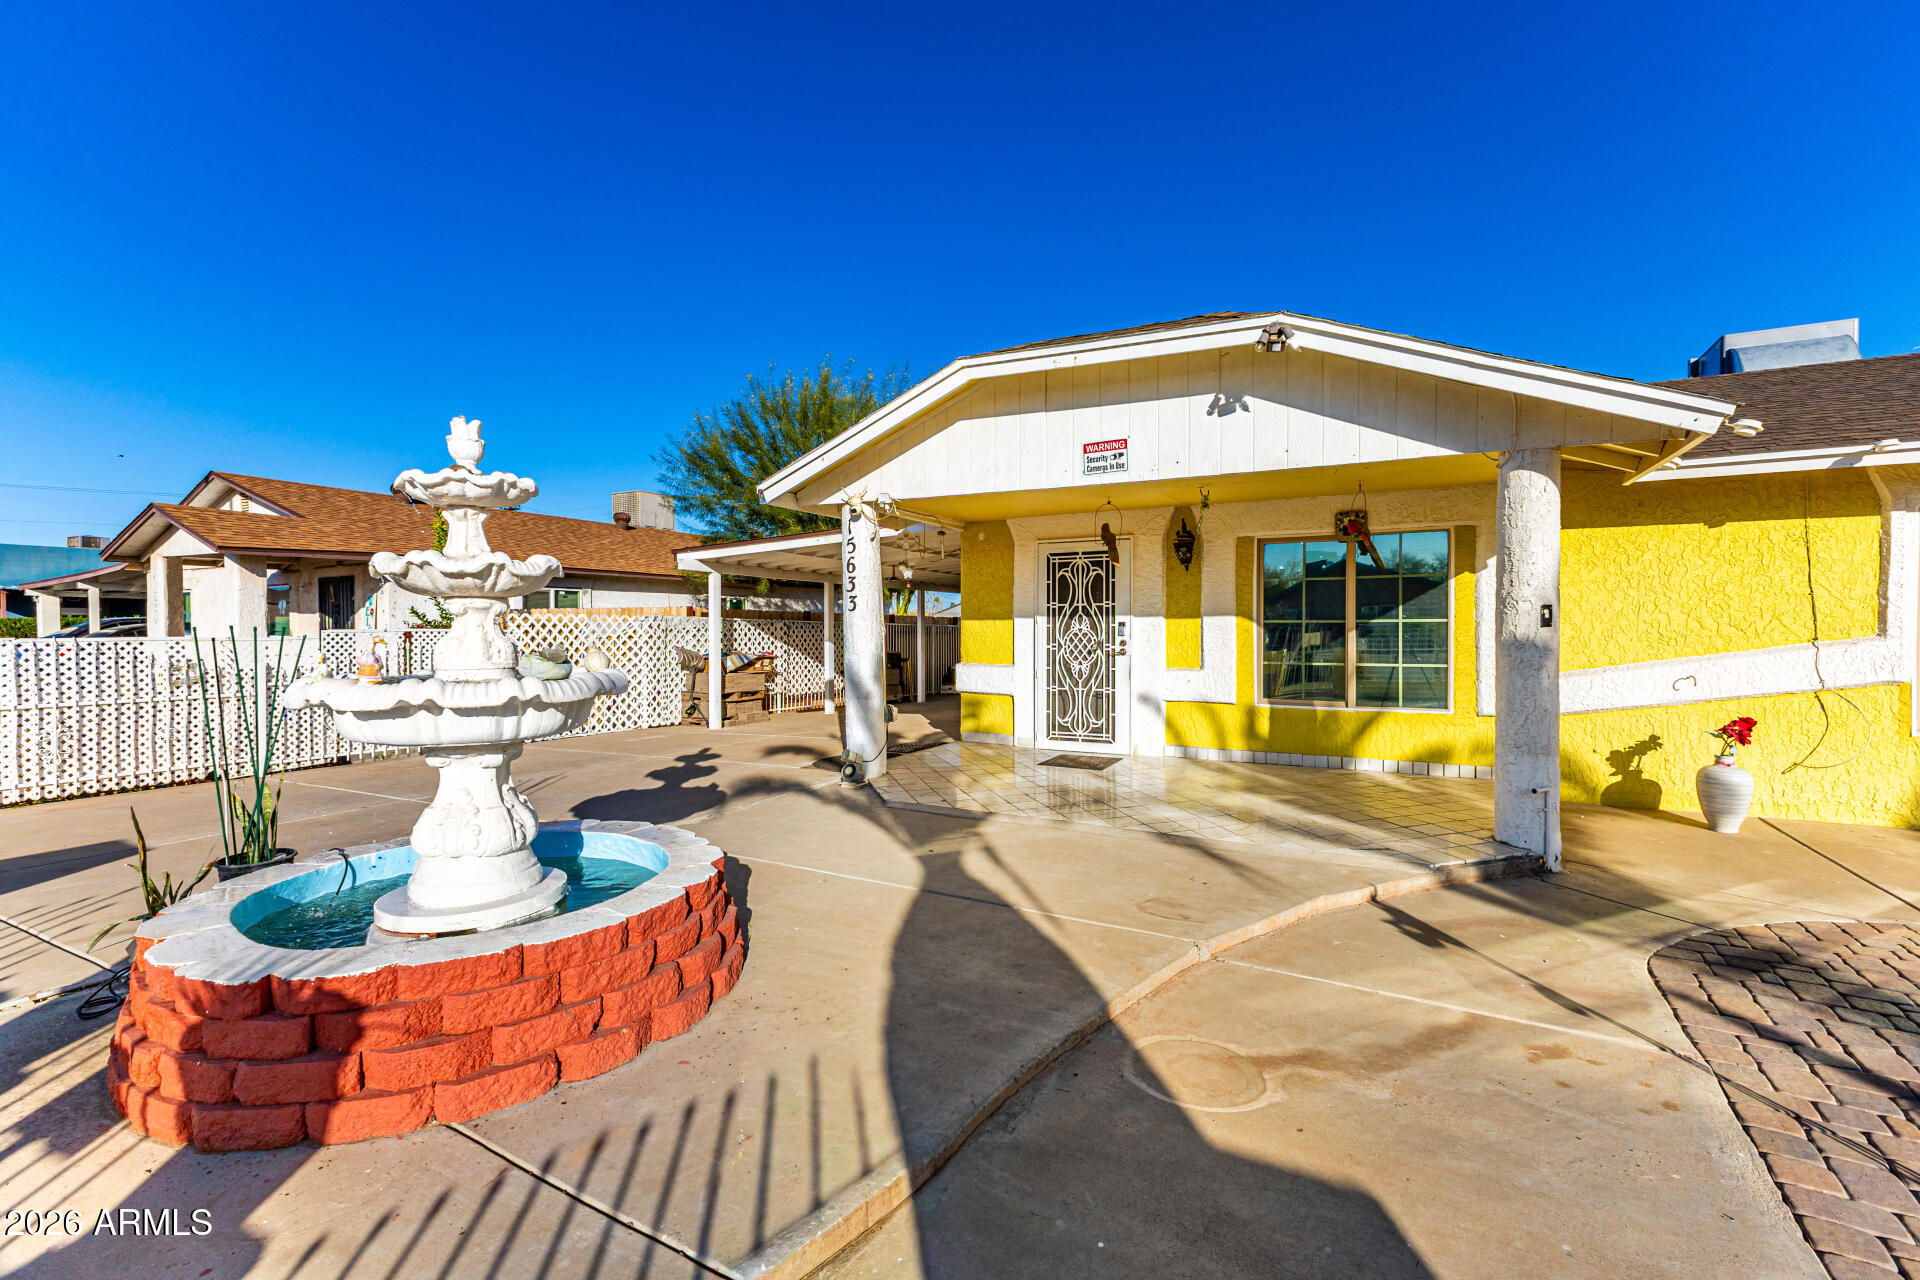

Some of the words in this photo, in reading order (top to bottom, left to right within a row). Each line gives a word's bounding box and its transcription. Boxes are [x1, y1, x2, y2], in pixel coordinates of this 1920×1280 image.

[1085, 440, 1126, 453] WARNING
[1086, 454, 1109, 464] Security
[1086, 464, 1109, 473] Cameras
[1115, 461, 1126, 470] Use
